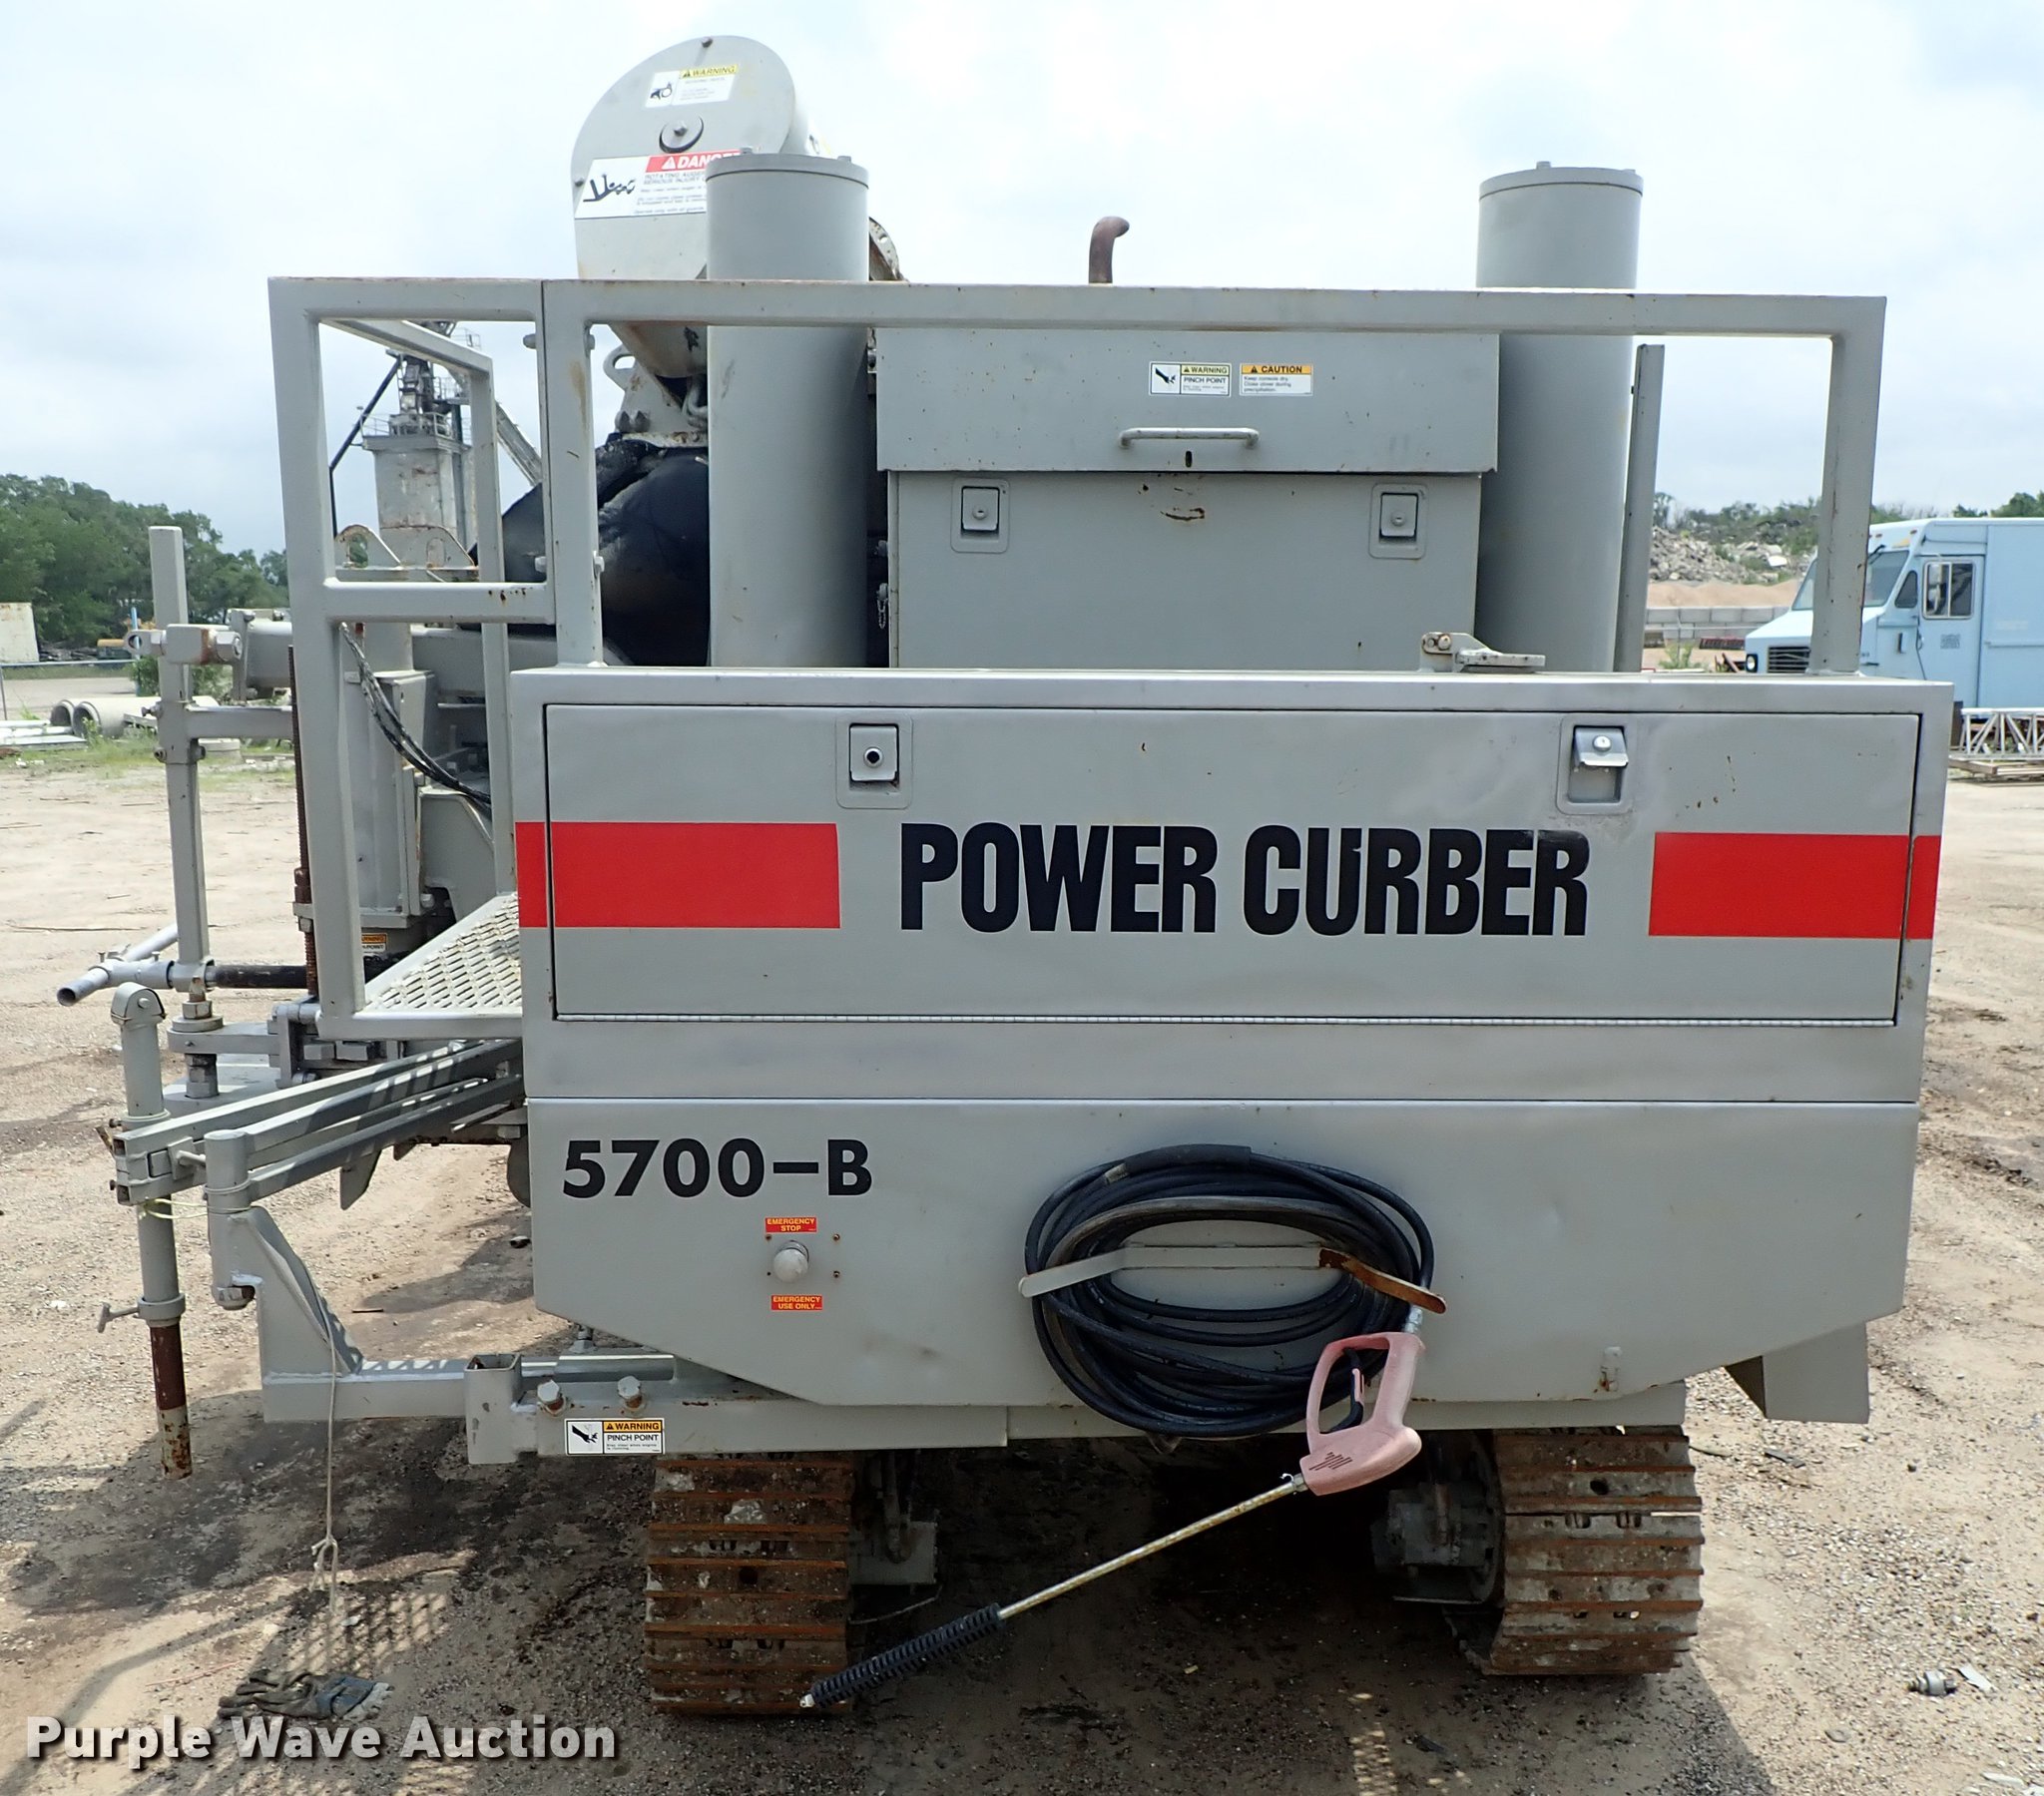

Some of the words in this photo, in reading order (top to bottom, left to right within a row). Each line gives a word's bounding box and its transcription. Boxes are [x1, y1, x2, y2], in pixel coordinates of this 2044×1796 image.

[692, 65, 736, 77] WARNING
[677, 153, 741, 169] DAN
[900, 822, 1218, 934] POWER
[1243, 824, 1590, 937] CURBER
[615, 1422, 660, 1431] WARNING
